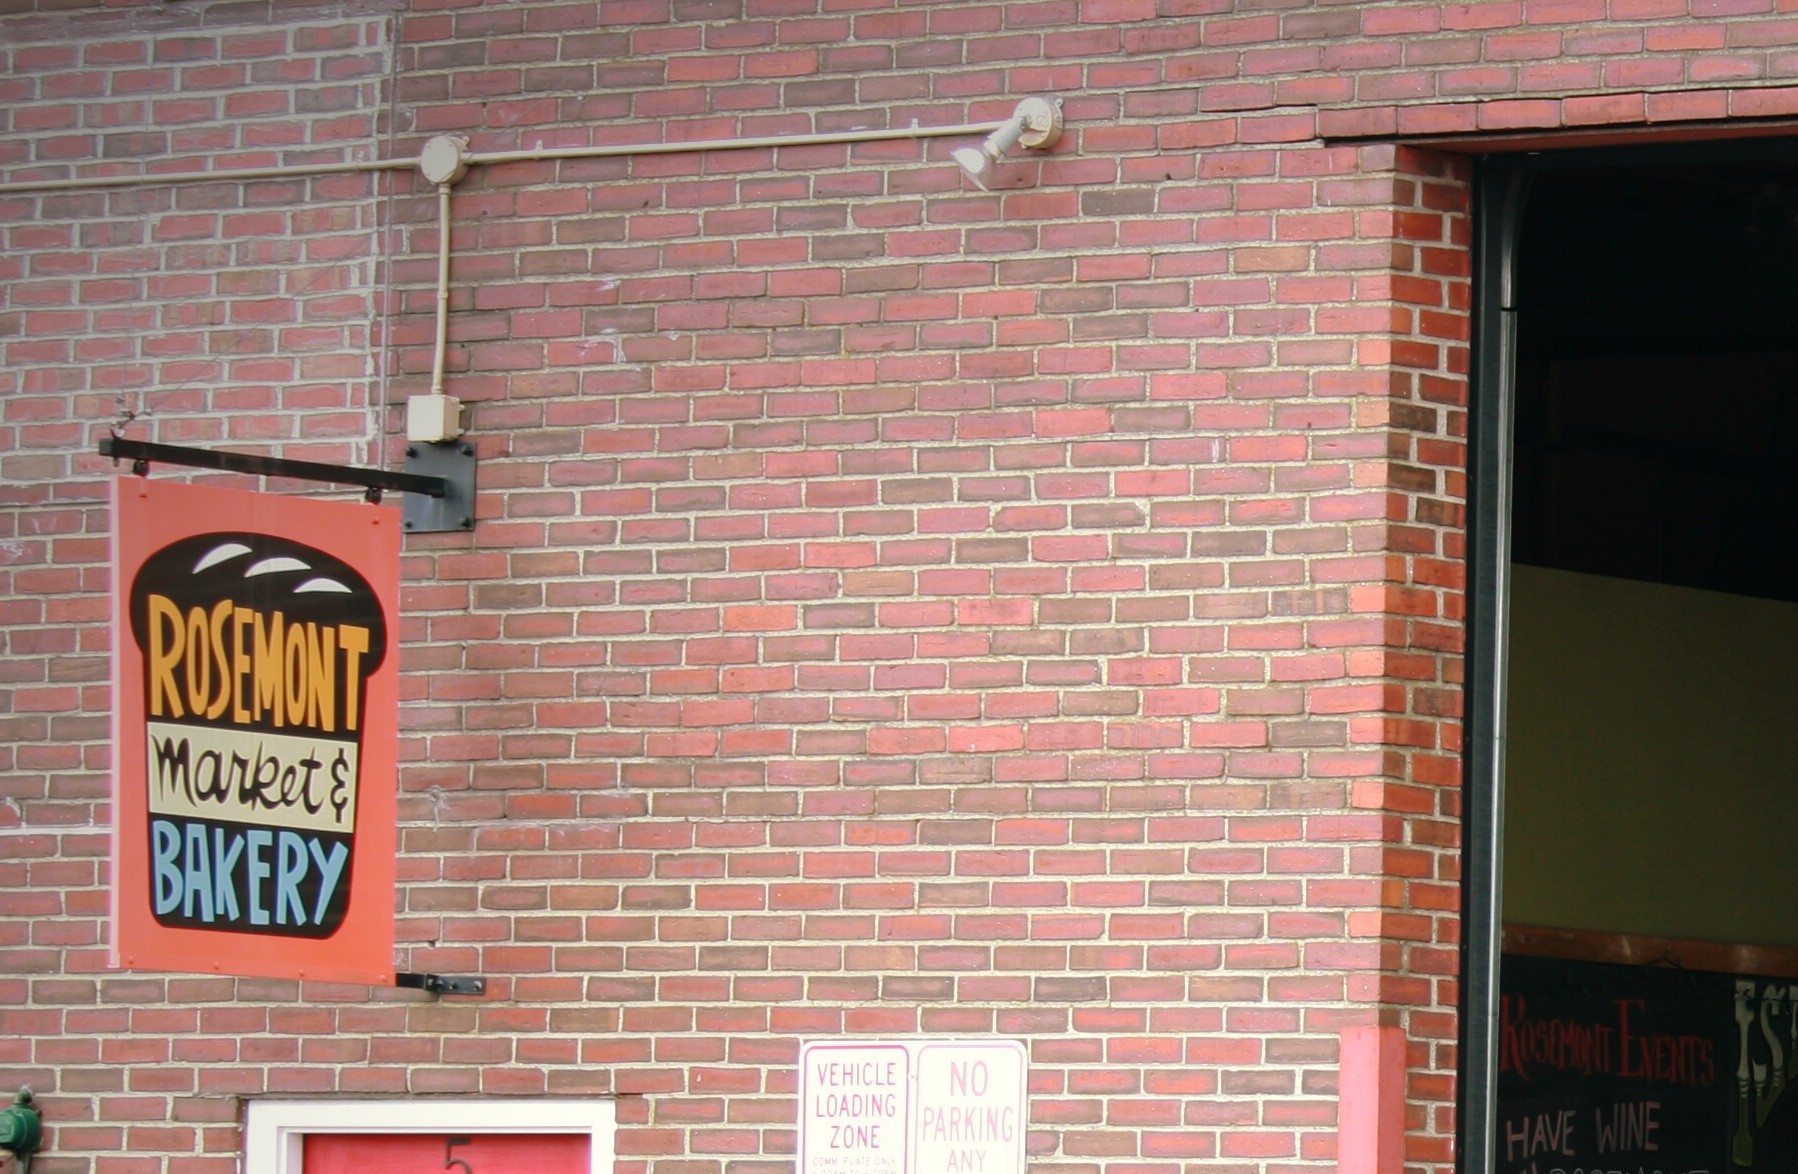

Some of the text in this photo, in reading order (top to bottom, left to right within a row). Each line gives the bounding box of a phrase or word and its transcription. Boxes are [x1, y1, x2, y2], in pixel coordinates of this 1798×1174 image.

[148, 594, 371, 732] ROSEMONT
[151, 733, 351, 824] Market &
[152, 820, 349, 925] BAKERY
[817, 1062, 897, 1086] VEHICLE
[950, 1060, 989, 1097] NO
[816, 1093, 896, 1118] LOADING
[922, 1105, 1013, 1142] PARKING
[830, 1125, 880, 1149] ZONE
[1506, 1100, 1661, 1161] HAVE WINE
[946, 1149, 987, 1172] ANY
